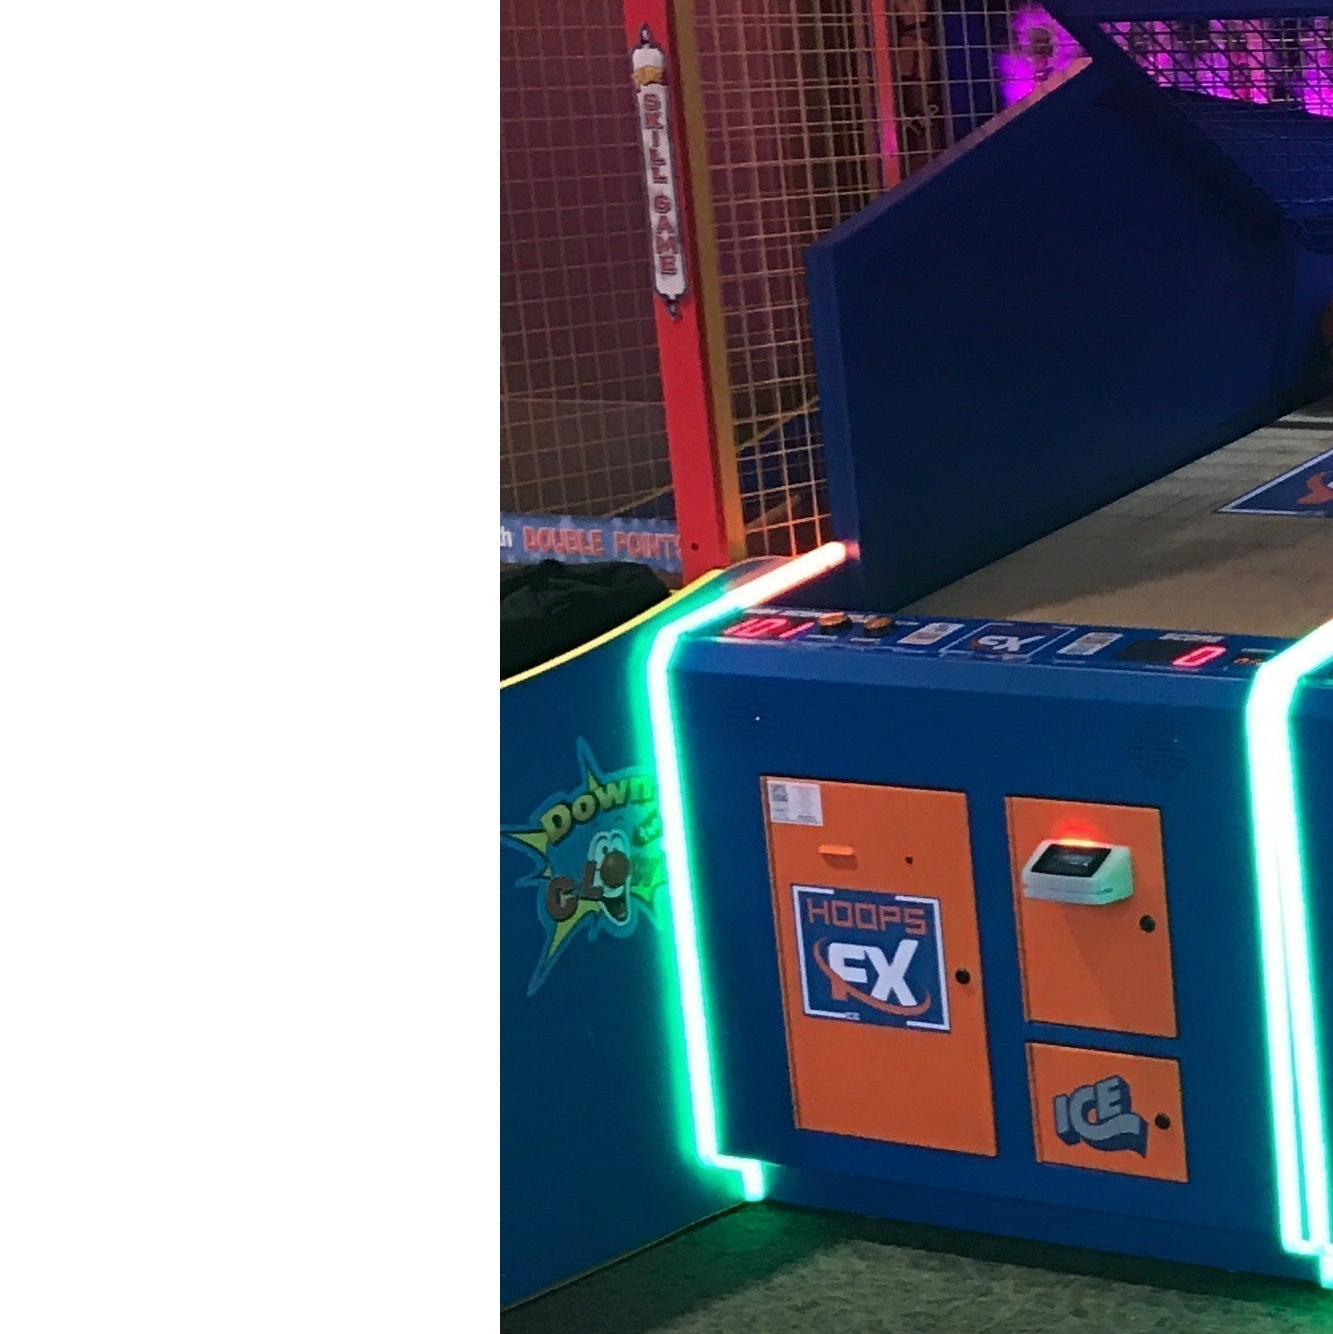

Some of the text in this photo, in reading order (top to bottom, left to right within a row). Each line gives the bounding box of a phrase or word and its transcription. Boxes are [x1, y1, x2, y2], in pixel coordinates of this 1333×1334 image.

[643, 93, 679, 276] SKILL GAME
[522, 525, 604, 556] DOUBLE
[807, 897, 927, 936] HOOPS
[828, 938, 919, 1007] FX
[1053, 1074, 1149, 1158] ICE
